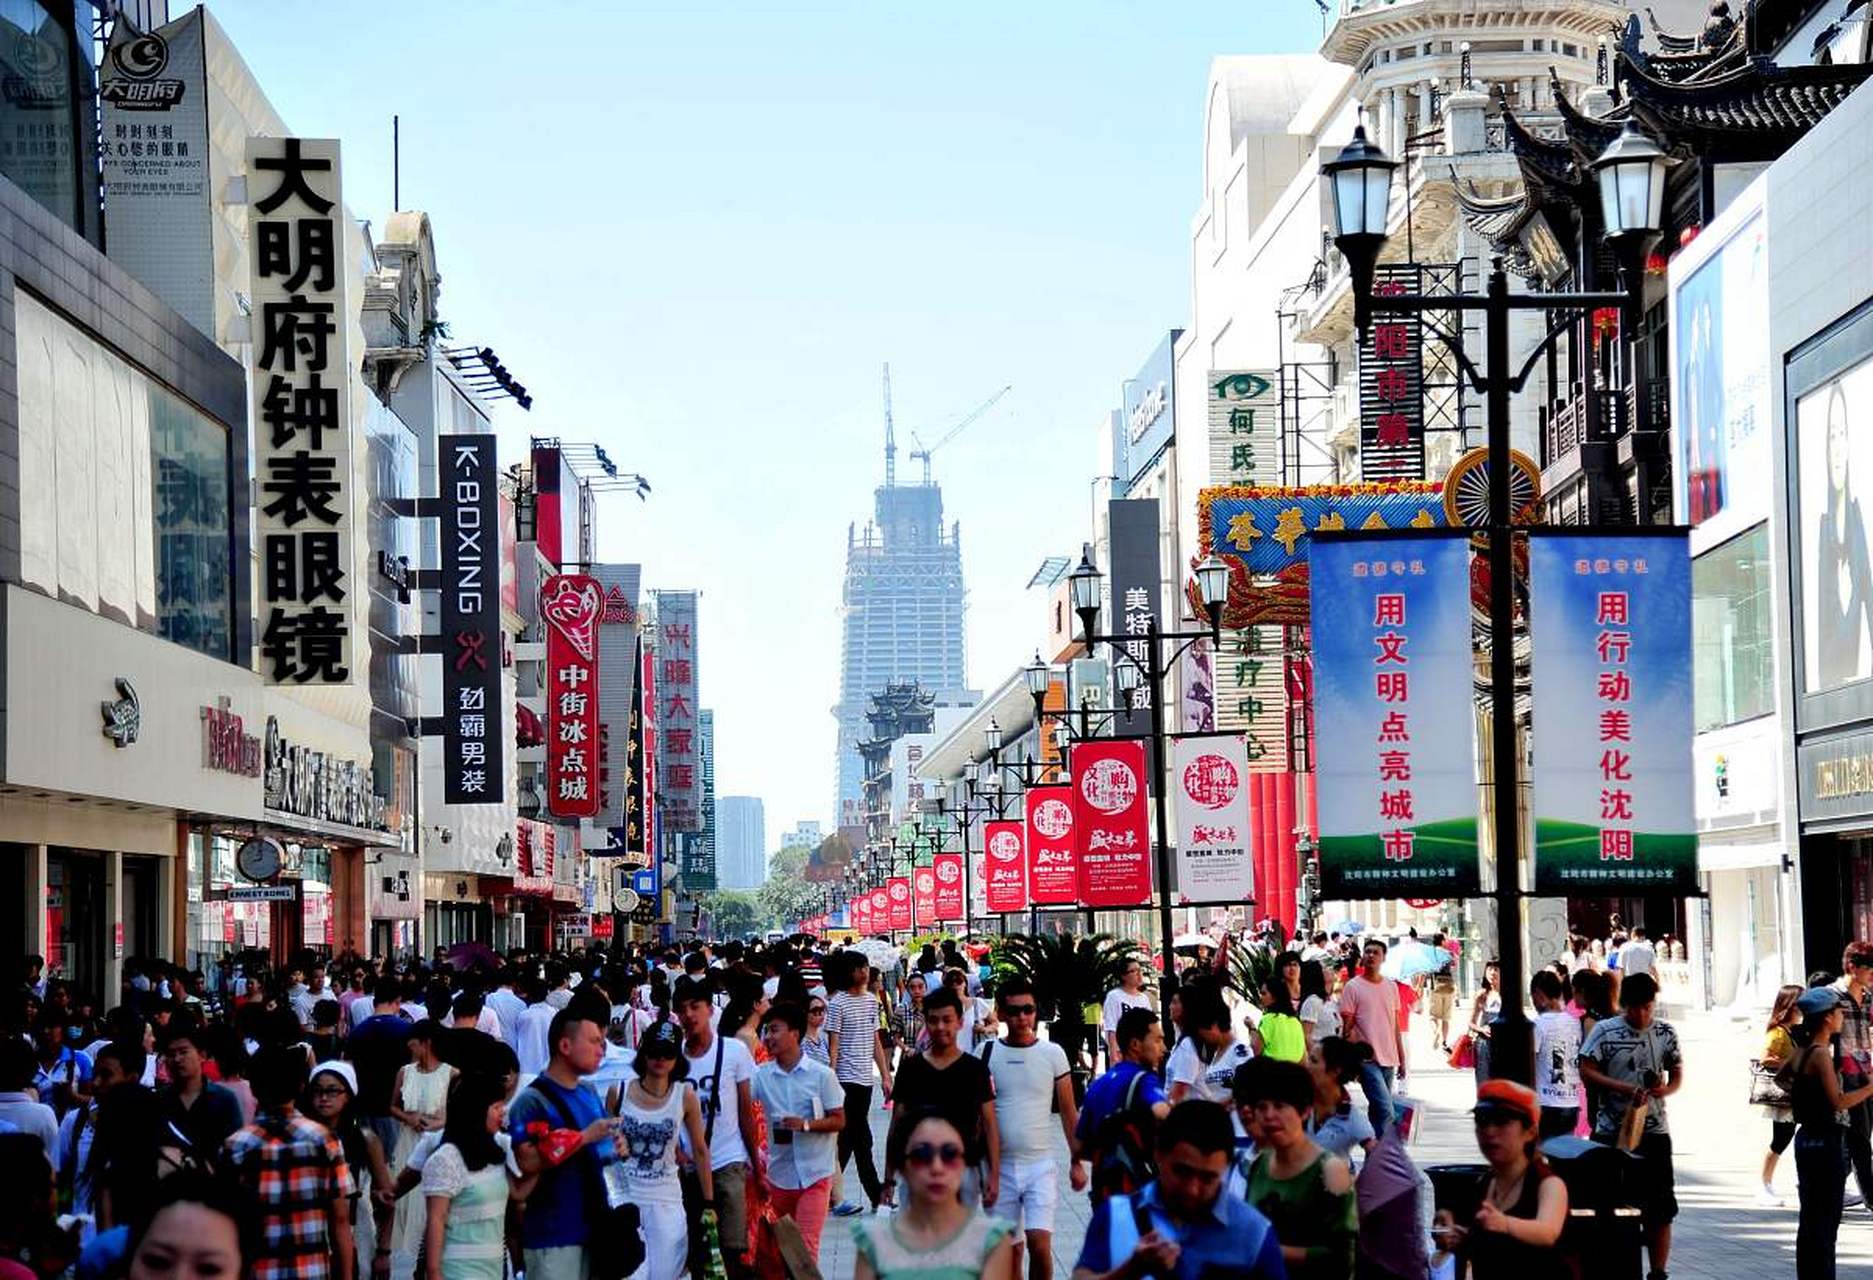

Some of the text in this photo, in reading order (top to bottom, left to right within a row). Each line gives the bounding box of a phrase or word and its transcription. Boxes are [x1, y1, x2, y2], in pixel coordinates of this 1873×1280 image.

[103, 80, 179, 100] 大明府
[254, 138, 349, 682] 大明府钟表眼镜
[455, 446, 482, 614] K-BOXING
[459, 687, 486, 793] 劲霸男装
[558, 664, 588, 800] 中街冰点城
[1374, 593, 1416, 862] 用文明点亮城市
[1596, 591, 1635, 861] 用行动美化沈阳
